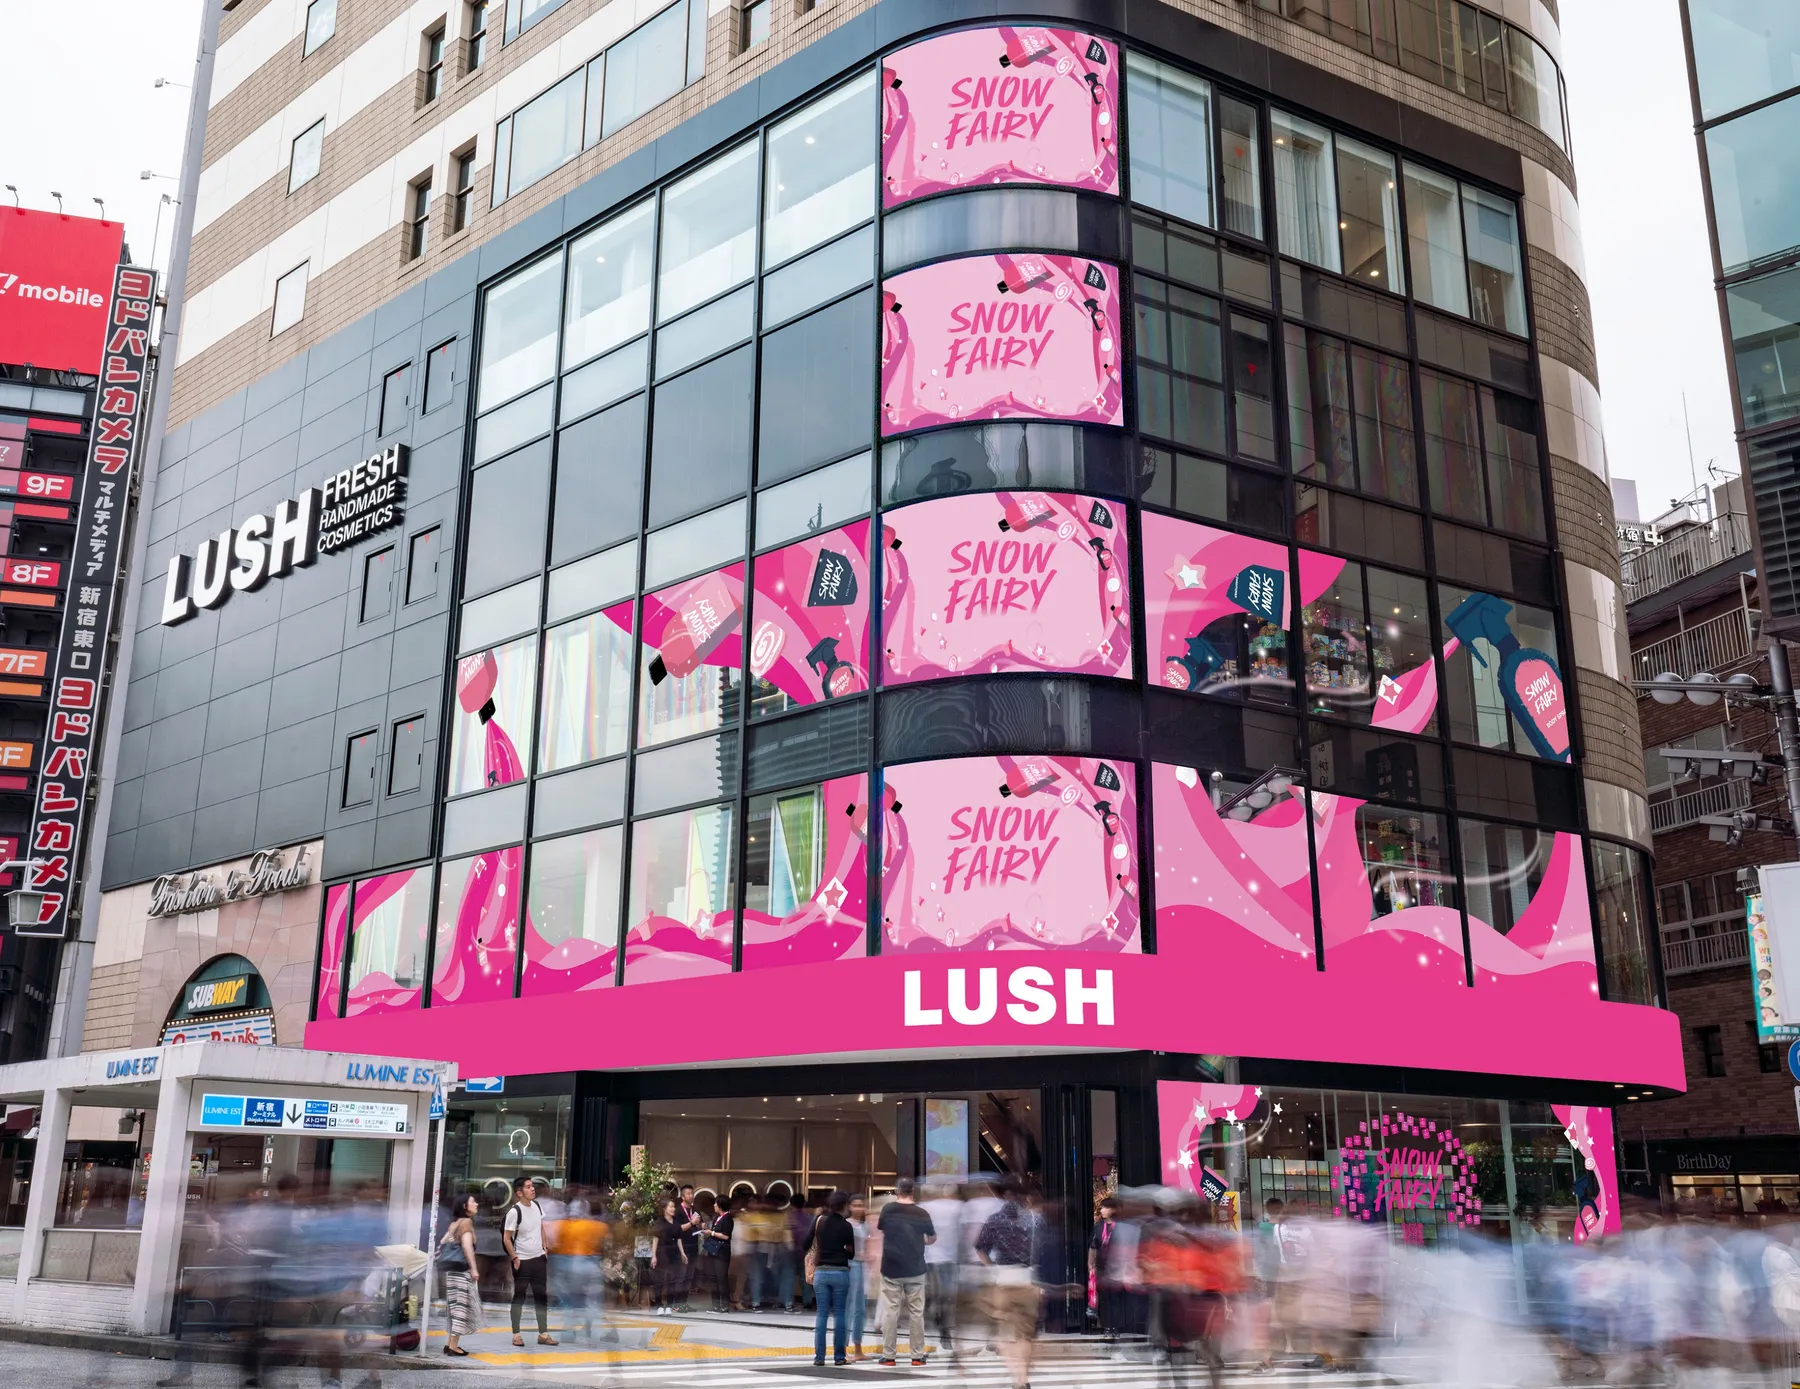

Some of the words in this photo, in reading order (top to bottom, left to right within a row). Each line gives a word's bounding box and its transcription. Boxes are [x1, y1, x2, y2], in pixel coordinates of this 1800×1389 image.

[948, 76, 1055, 109] SNOW
[944, 103, 1055, 150] FAIRY
[947, 300, 1055, 335] SNOW
[93, 269, 154, 475] ヨドバシカメラ
[944, 329, 1055, 379] FAIRY
[26, 475, 65, 496] 9F
[321, 443, 400, 509] FRESH
[318, 479, 397, 532] HANDMADE
[86, 480, 116, 577] マルチメディア
[316, 504, 394, 553] COSMETICS
[12, 564, 52, 584] 8F
[161, 487, 314, 626] LUSH
[947, 540, 1057, 576] SNOW
[818, 558, 835, 600] SNOW
[828, 559, 845, 600] FAIRY
[943, 569, 1057, 624] FAIRY
[1247, 569, 1261, 611] FAIRY
[1261, 573, 1274, 615] SNOW
[70, 586, 101, 671] 新宿東口
[685, 609, 711, 643] SNOW
[696, 599, 721, 630] FAIRY
[0, 653, 38, 673] 7F
[1166, 667, 1188, 684] SNOW
[1525, 671, 1551, 702] SNOW
[1534, 684, 1558, 715] FAIRY
[1546, 717, 1558, 729] BODY
[947, 806, 1060, 843] SNOW
[943, 836, 1060, 894] FAIRY
[147, 869, 220, 917] Fashion
[187, 978, 245, 1010] SUBWAY
[904, 965, 1115, 1027] LUSH
[106, 1058, 141, 1079] LUMINE
[141, 1055, 160, 1075] EST
[346, 1062, 409, 1084] LUMINE
[412, 1067, 438, 1085] EST
[204, 1106, 229, 1115] LUMINE
[230, 1107, 242, 1115] EST
[256, 1102, 275, 1112] 新宿
[1374, 1146, 1444, 1178] SNOW
[1676, 1153, 1732, 1170] BirthDay
[1202, 1179, 1222, 1195] SNOW
[1373, 1173, 1445, 1213] FAIRY
